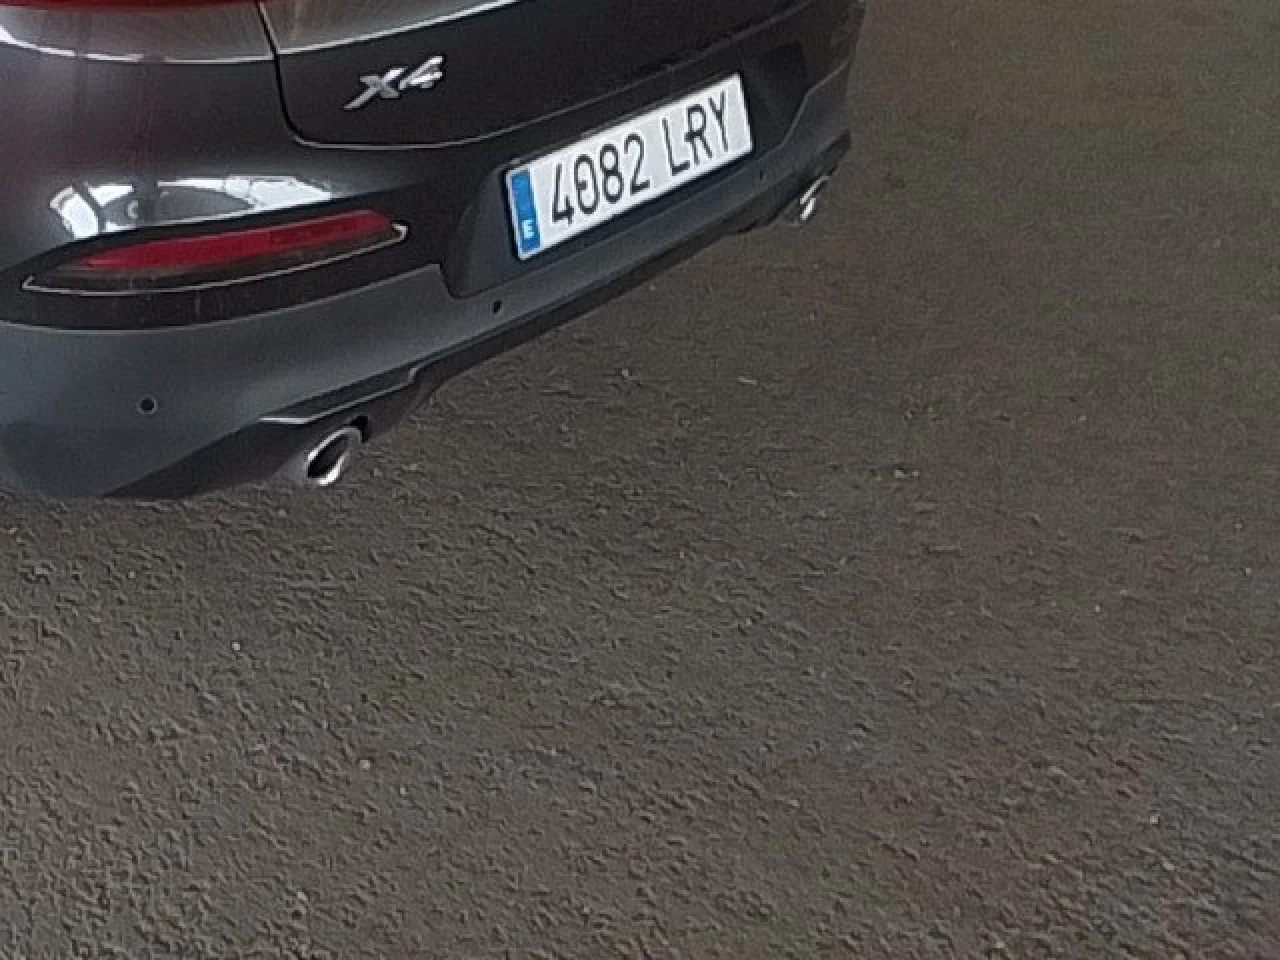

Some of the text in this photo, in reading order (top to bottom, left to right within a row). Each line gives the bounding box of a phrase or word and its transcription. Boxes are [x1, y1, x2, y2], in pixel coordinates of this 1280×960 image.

[342, 54, 444, 111] X4
[551, 90, 730, 226] 4082 LRY
[521, 218, 536, 240] E
